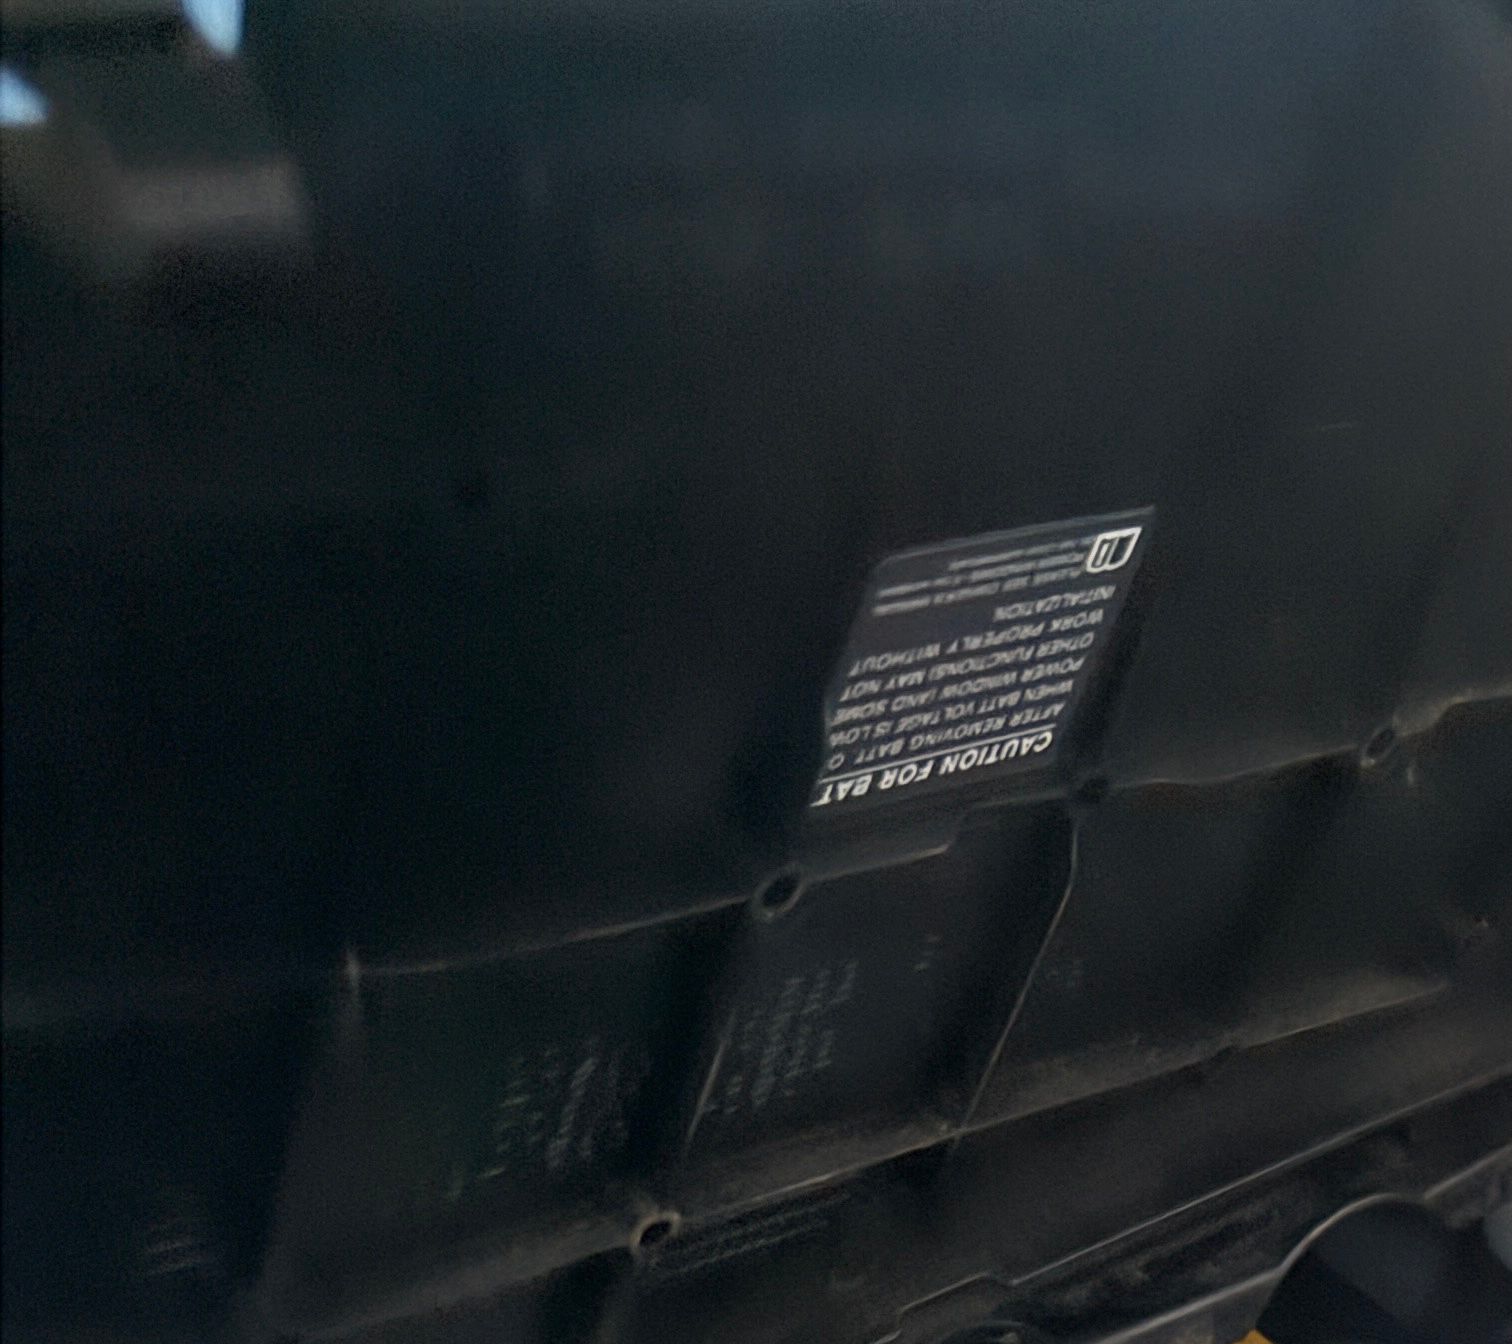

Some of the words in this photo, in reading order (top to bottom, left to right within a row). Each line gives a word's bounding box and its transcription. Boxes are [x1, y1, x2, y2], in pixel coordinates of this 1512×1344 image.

[1047, 607, 1105, 633] WORK
[945, 620, 1044, 655] PROPERLY
[1035, 631, 1095, 658] OTHER
[849, 642, 941, 676] WITHOUT
[1020, 654, 1085, 682] POWER
[839, 678, 882, 701] NOT
[883, 669, 925, 692] MAY
[940, 669, 1019, 701] WINDOW
[1020, 678, 1075, 703] WHEN
[872, 720, 893, 737] IS
[895, 701, 976, 732] VOLTAGE
[1008, 701, 1065, 727] AFTER
[909, 714, 1006, 750] REMOVING
[939, 729, 1054, 775] CAUTION
[877, 758, 934, 790] FOR
[811, 773, 872, 806] BAT
